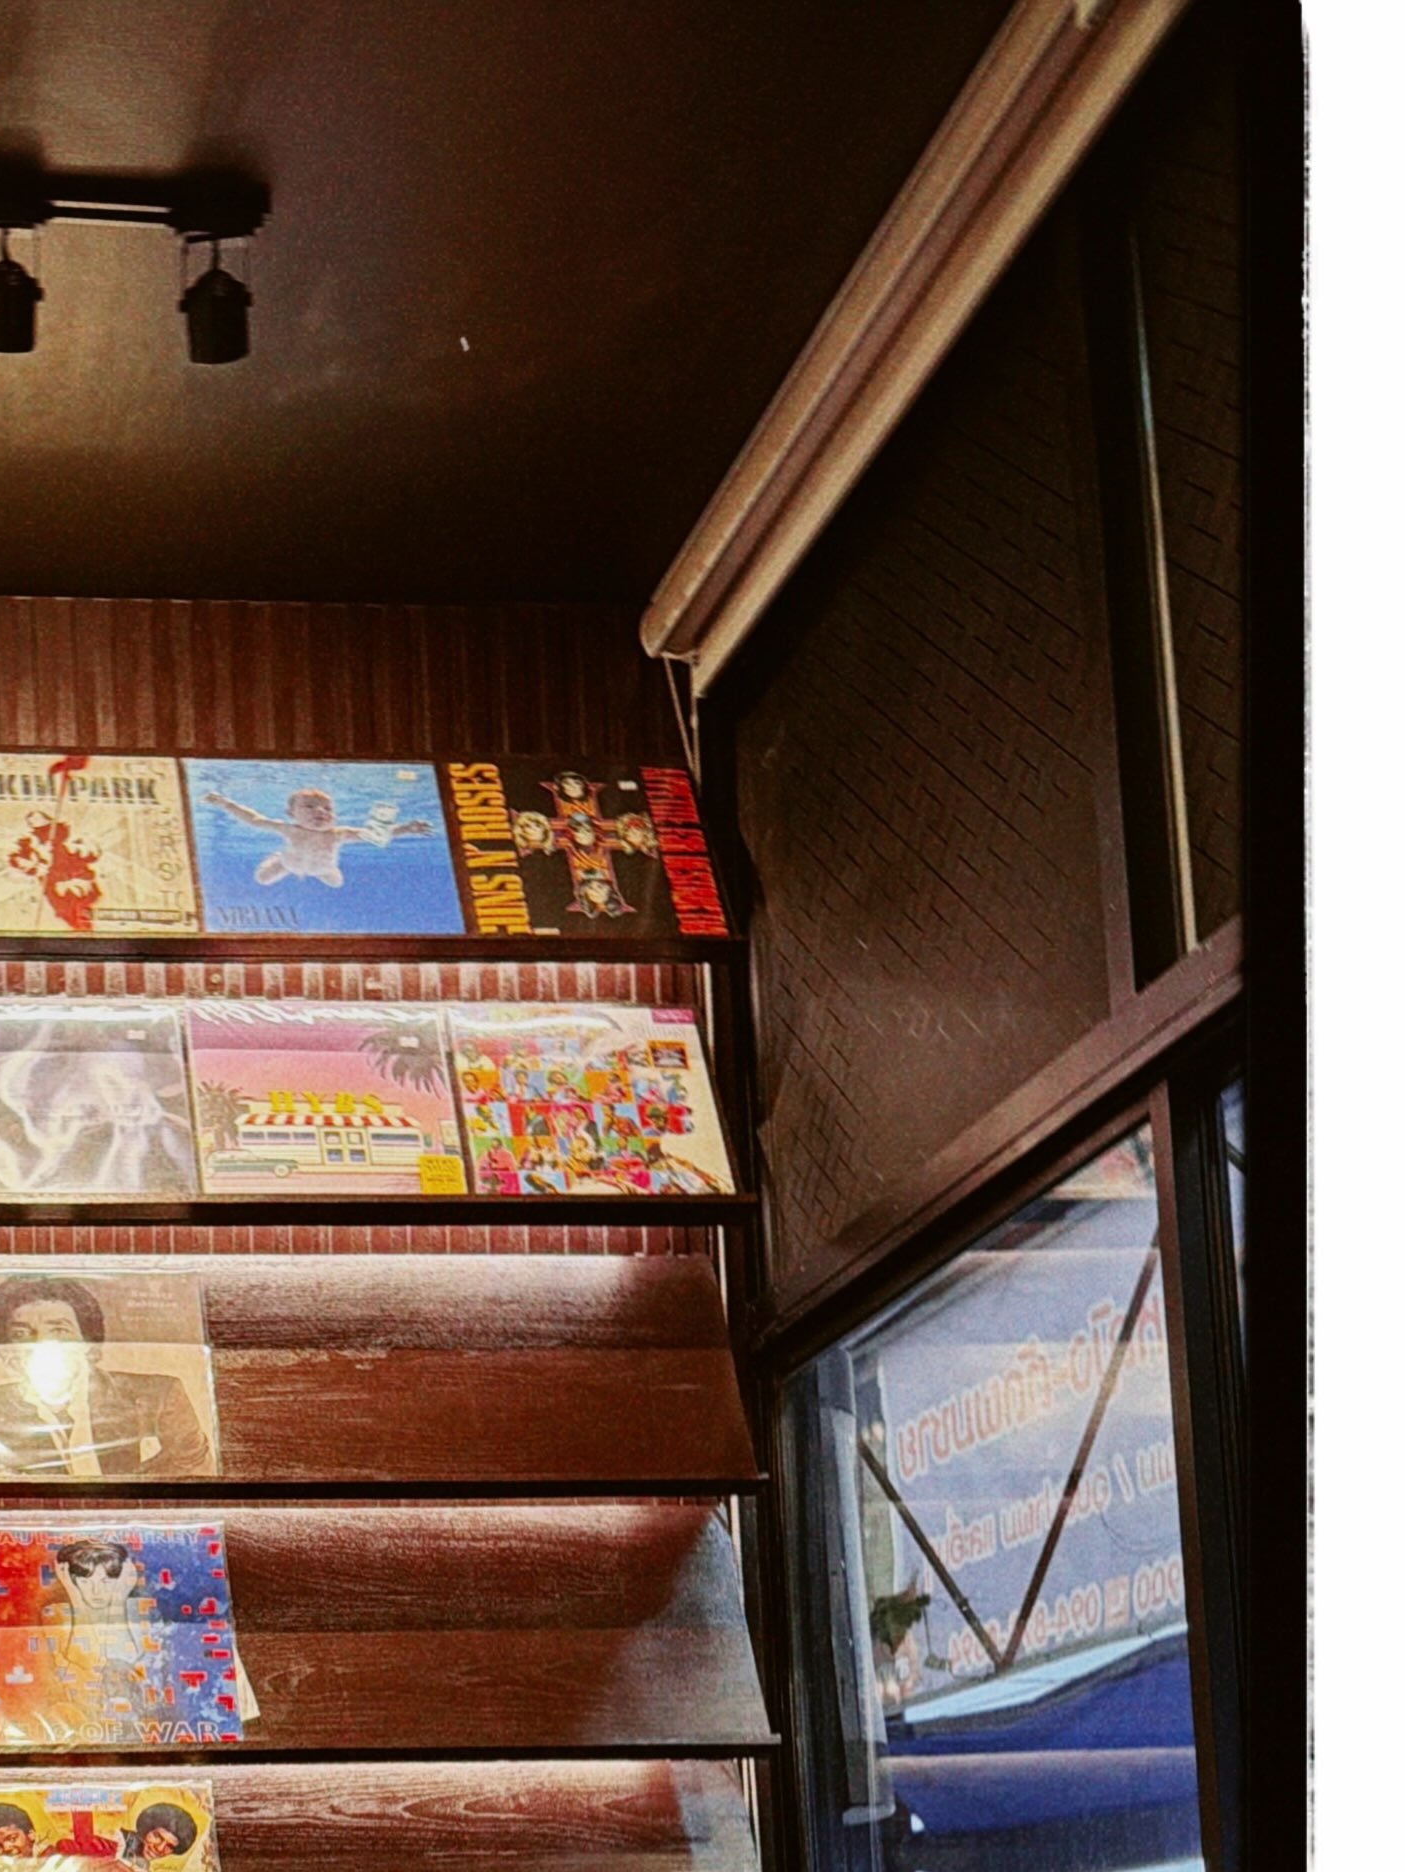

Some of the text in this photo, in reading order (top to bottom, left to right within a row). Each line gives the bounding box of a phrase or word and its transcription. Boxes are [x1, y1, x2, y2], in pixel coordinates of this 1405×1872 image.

[68, 776, 160, 804] PARK
[448, 762, 513, 841] ROSES
[267, 1089, 384, 1114] HYBS
[78, 1721, 125, 1743] OF
[133, 1719, 224, 1743] WAR
